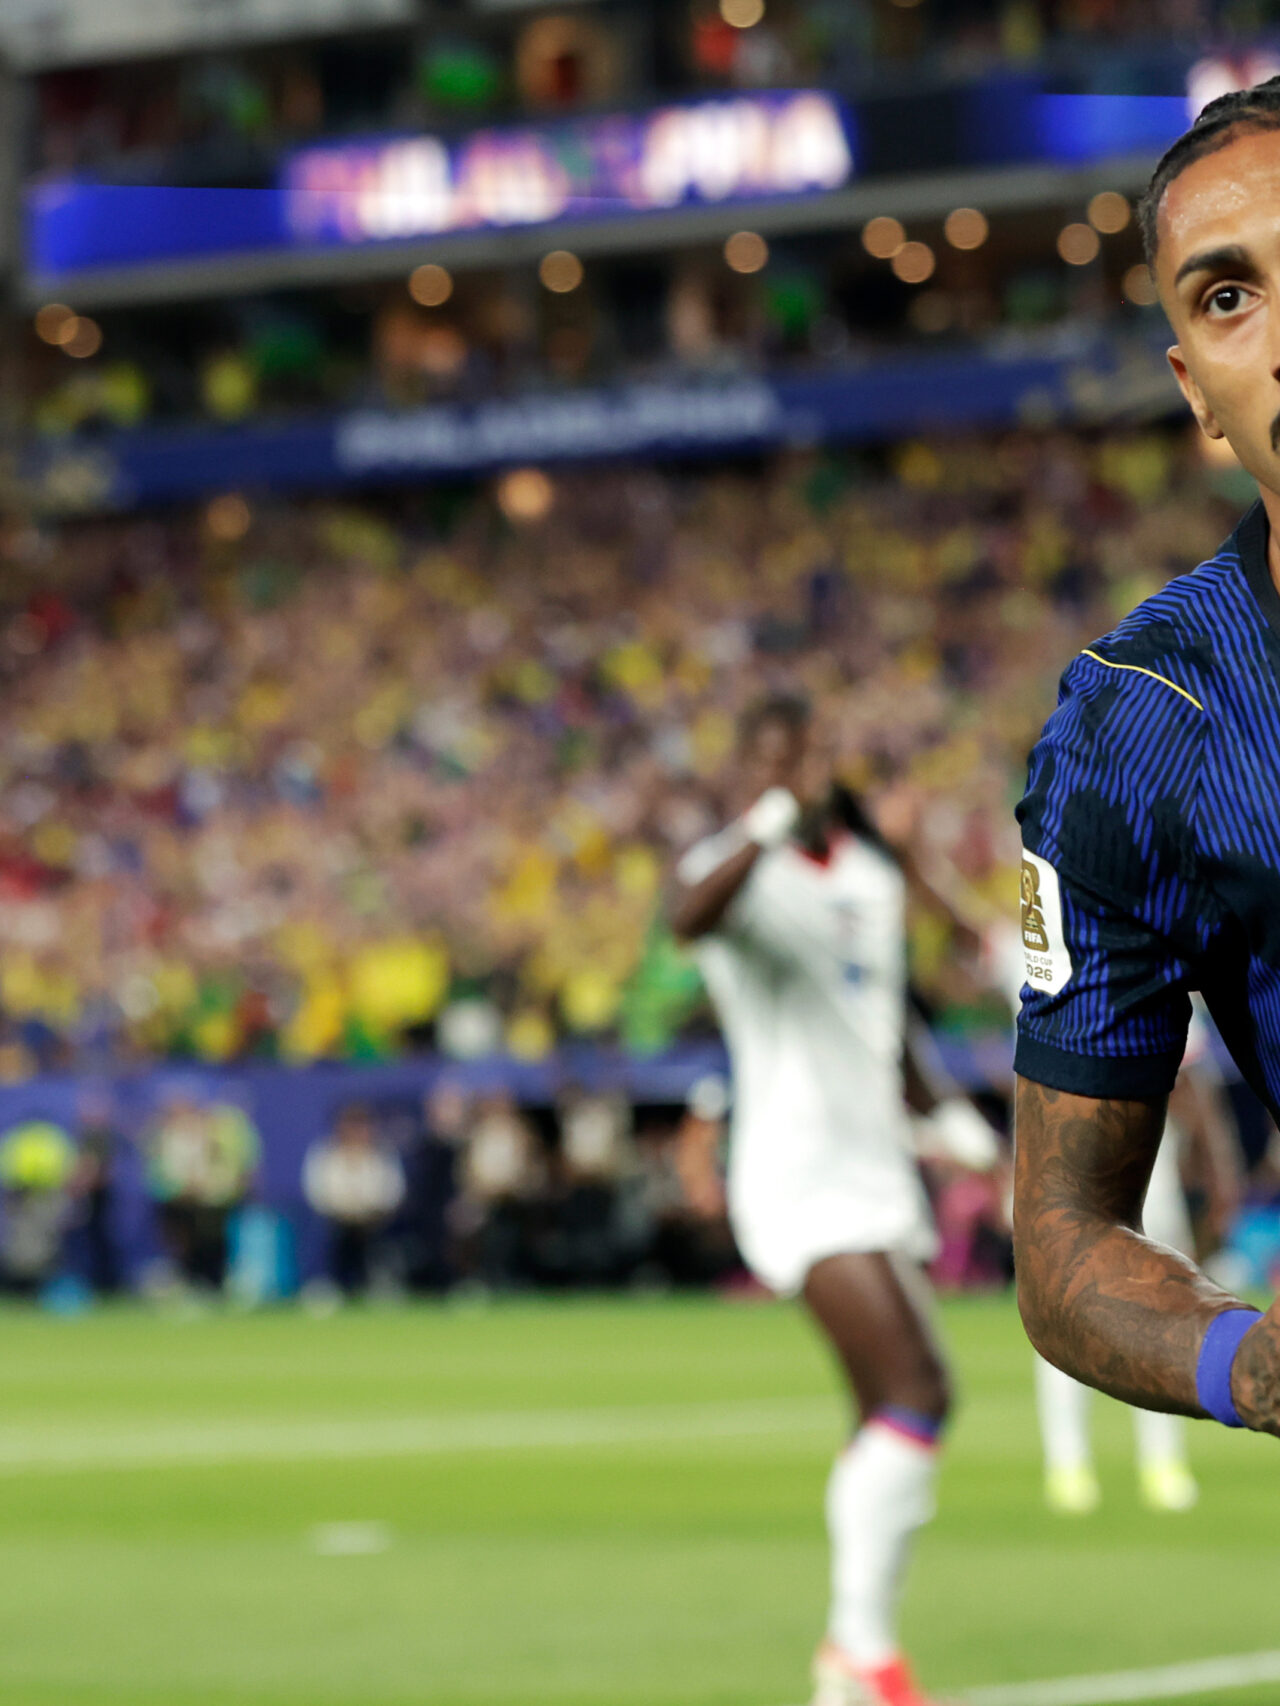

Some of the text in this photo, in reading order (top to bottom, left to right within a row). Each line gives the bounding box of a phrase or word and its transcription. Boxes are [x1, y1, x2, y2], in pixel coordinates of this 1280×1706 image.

[1024, 930, 1045, 945] FIFA
[1040, 957, 1053, 966] CUP
[1026, 963, 1053, 981] 026
